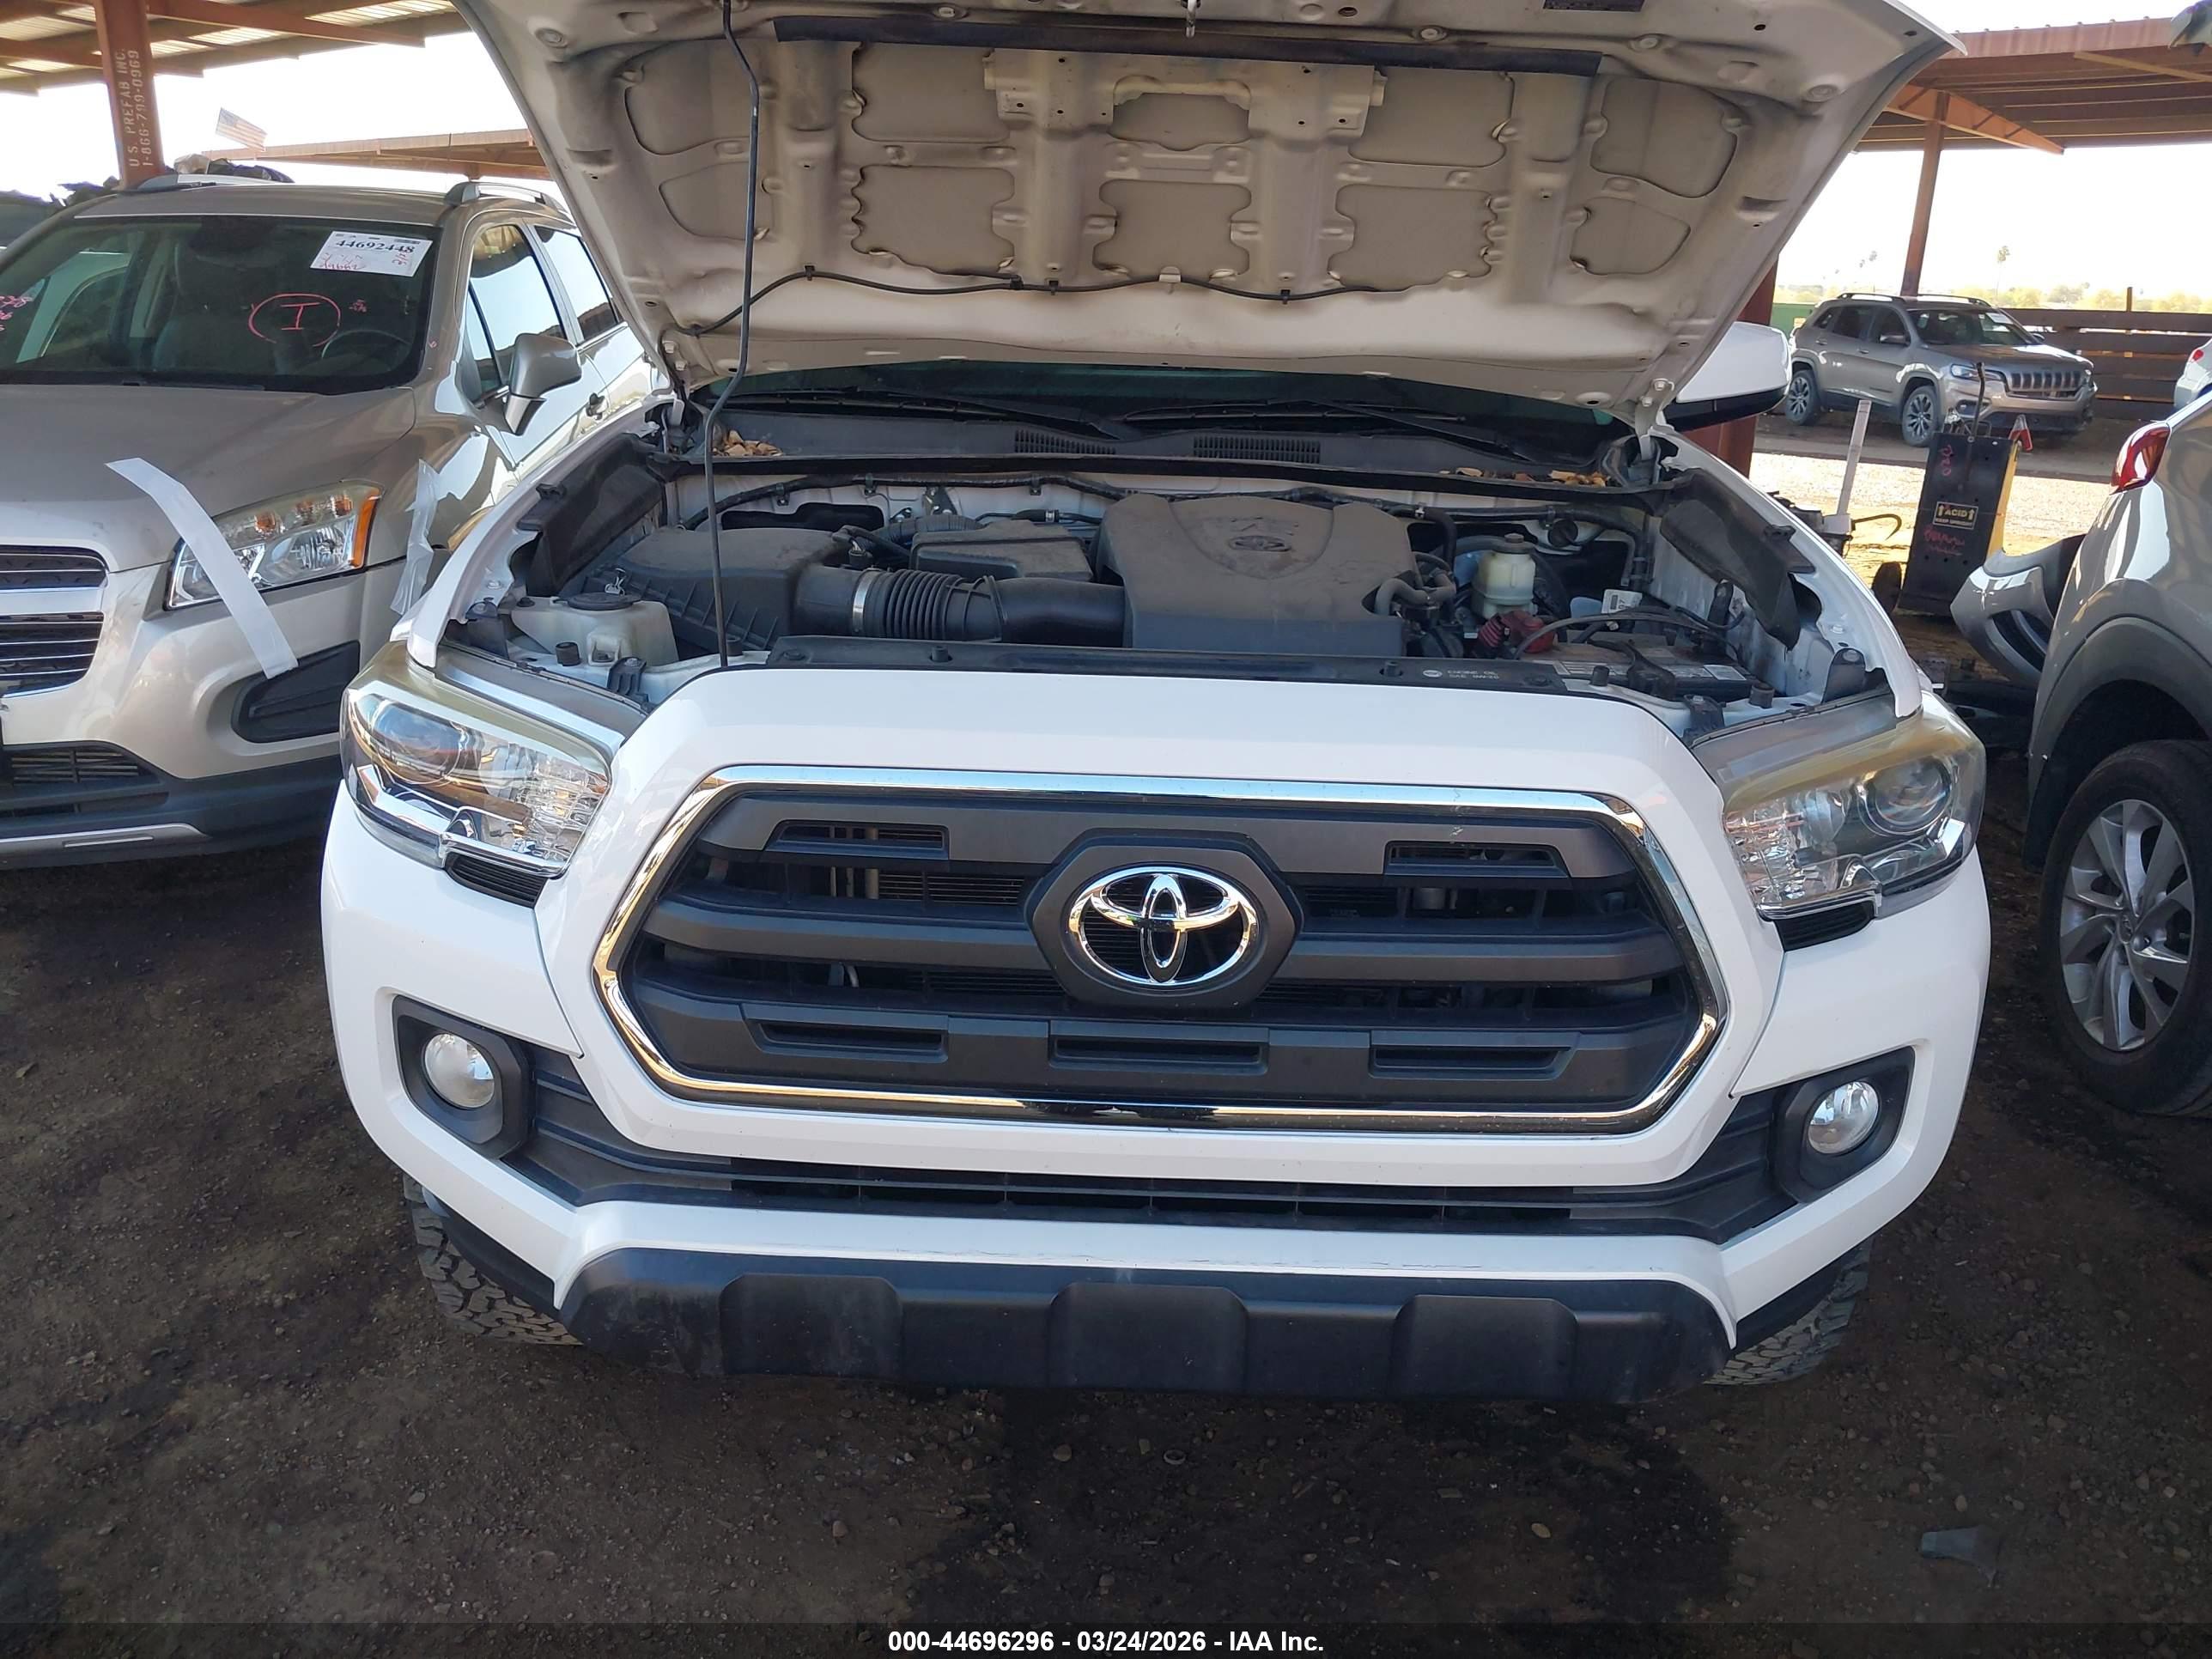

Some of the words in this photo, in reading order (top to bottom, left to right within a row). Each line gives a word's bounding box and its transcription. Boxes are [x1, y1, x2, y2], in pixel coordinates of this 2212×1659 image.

[115, 48, 128, 75] INC.
[118, 82, 137, 134] PREFAB
[127, 50, 154, 166] 1-866-799-0969
[336, 240, 416, 253] 44692448
[1944, 508, 1968, 518] ACID
